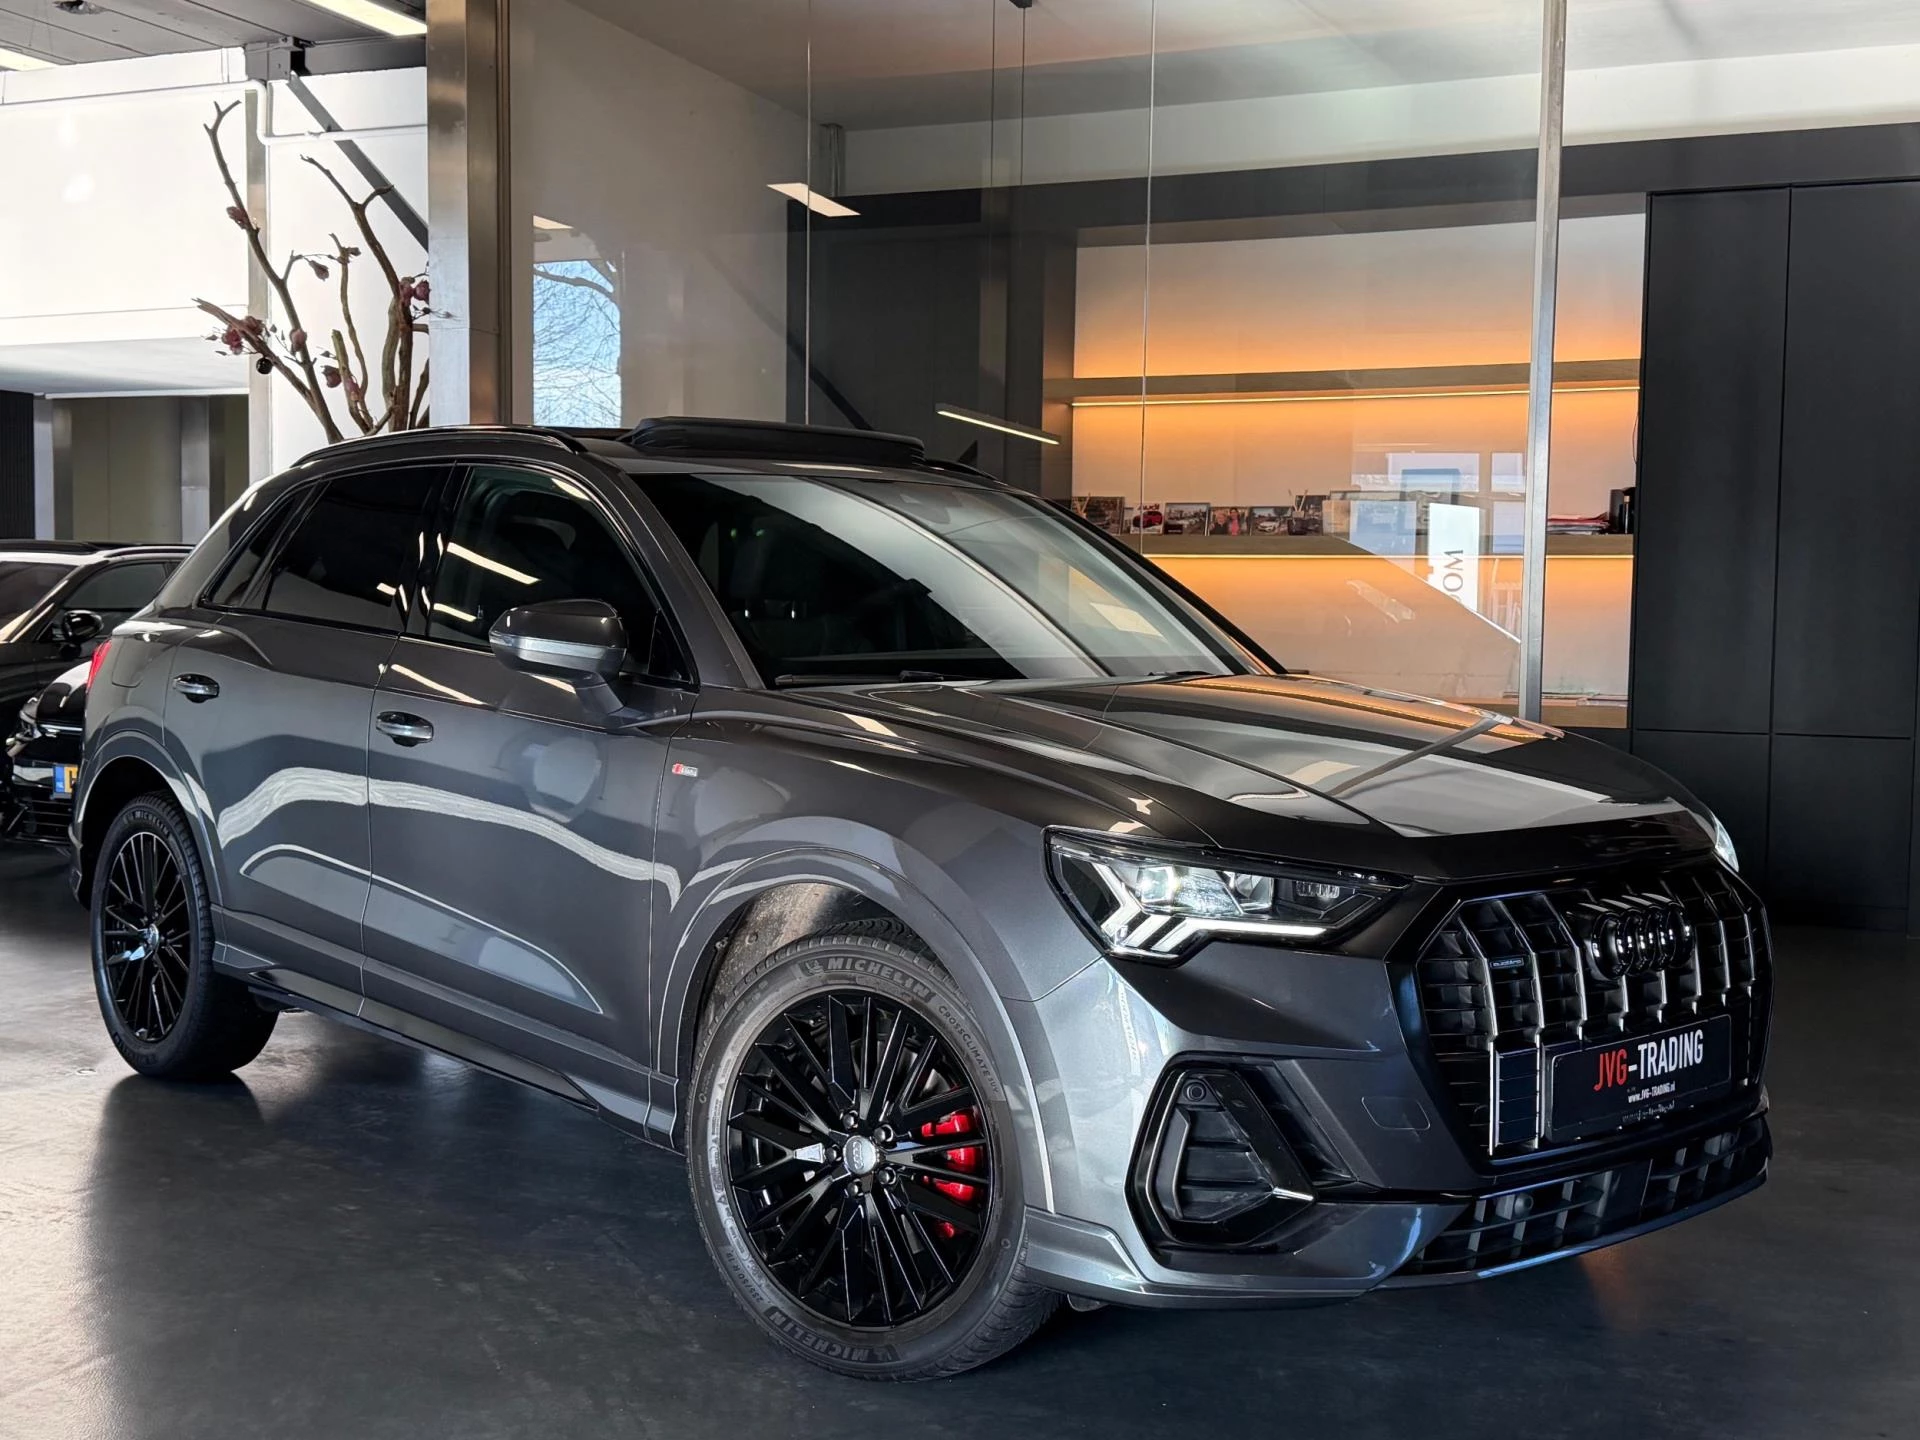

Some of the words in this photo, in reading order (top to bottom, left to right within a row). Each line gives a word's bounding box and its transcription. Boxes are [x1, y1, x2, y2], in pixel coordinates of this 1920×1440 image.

[1442, 549, 1464, 601] OM
[827, 957, 931, 999] MICHELIN
[938, 1005, 991, 1077] CROSSCLIMATE
[1593, 1029, 1703, 1091] JVG-TRADING
[768, 1310, 870, 1362] MICHELIN
